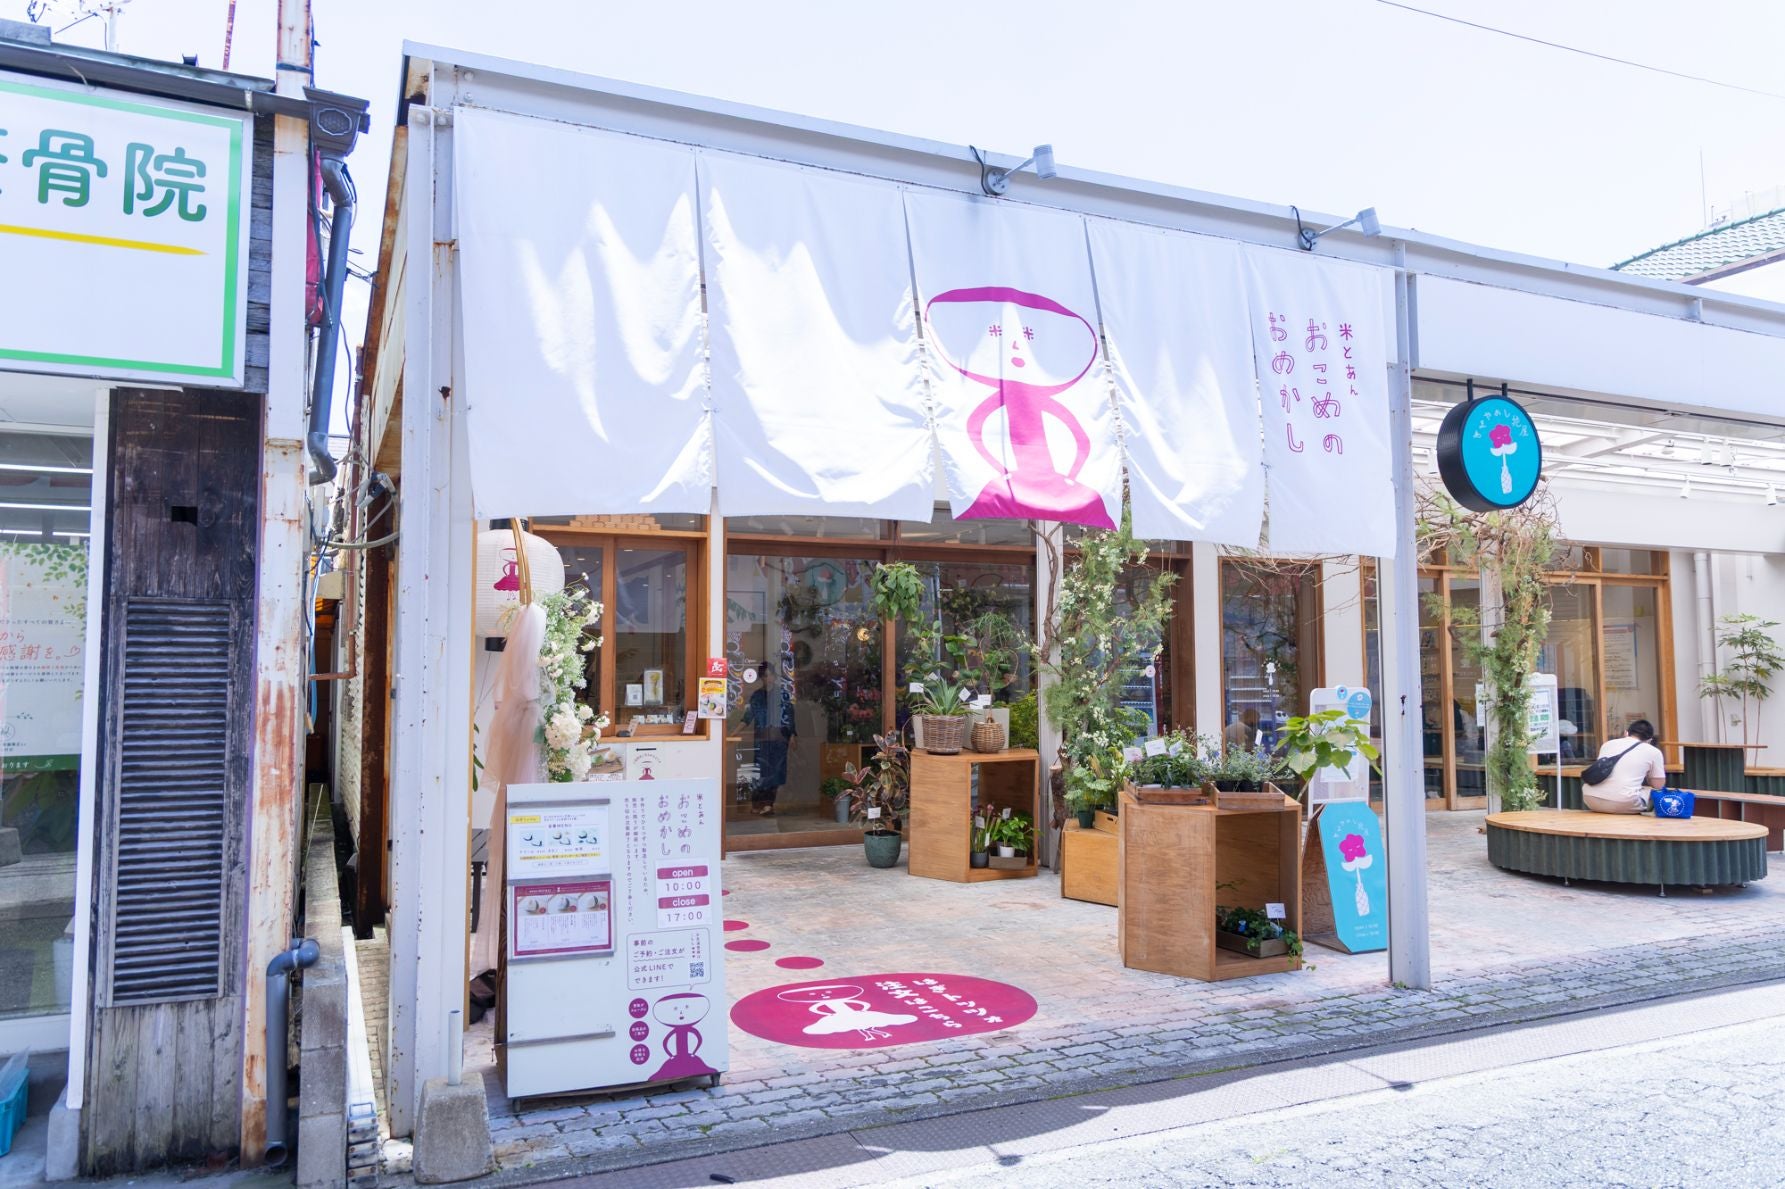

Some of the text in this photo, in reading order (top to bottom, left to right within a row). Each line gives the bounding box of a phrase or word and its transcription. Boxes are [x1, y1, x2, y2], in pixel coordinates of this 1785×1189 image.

[0, 128, 207, 222] 骨院
[1268, 312, 1304, 453] おめかし
[1304, 318, 1343, 455] おこめの
[1338, 322, 1359, 397] 米とあん
[657, 794, 673, 856] おめかし
[677, 793, 692, 854] おこめの
[665, 880, 701, 892] 10:00
[672, 867, 694, 878] open
[672, 897, 696, 907] close
[666, 911, 703, 922] 17:00
